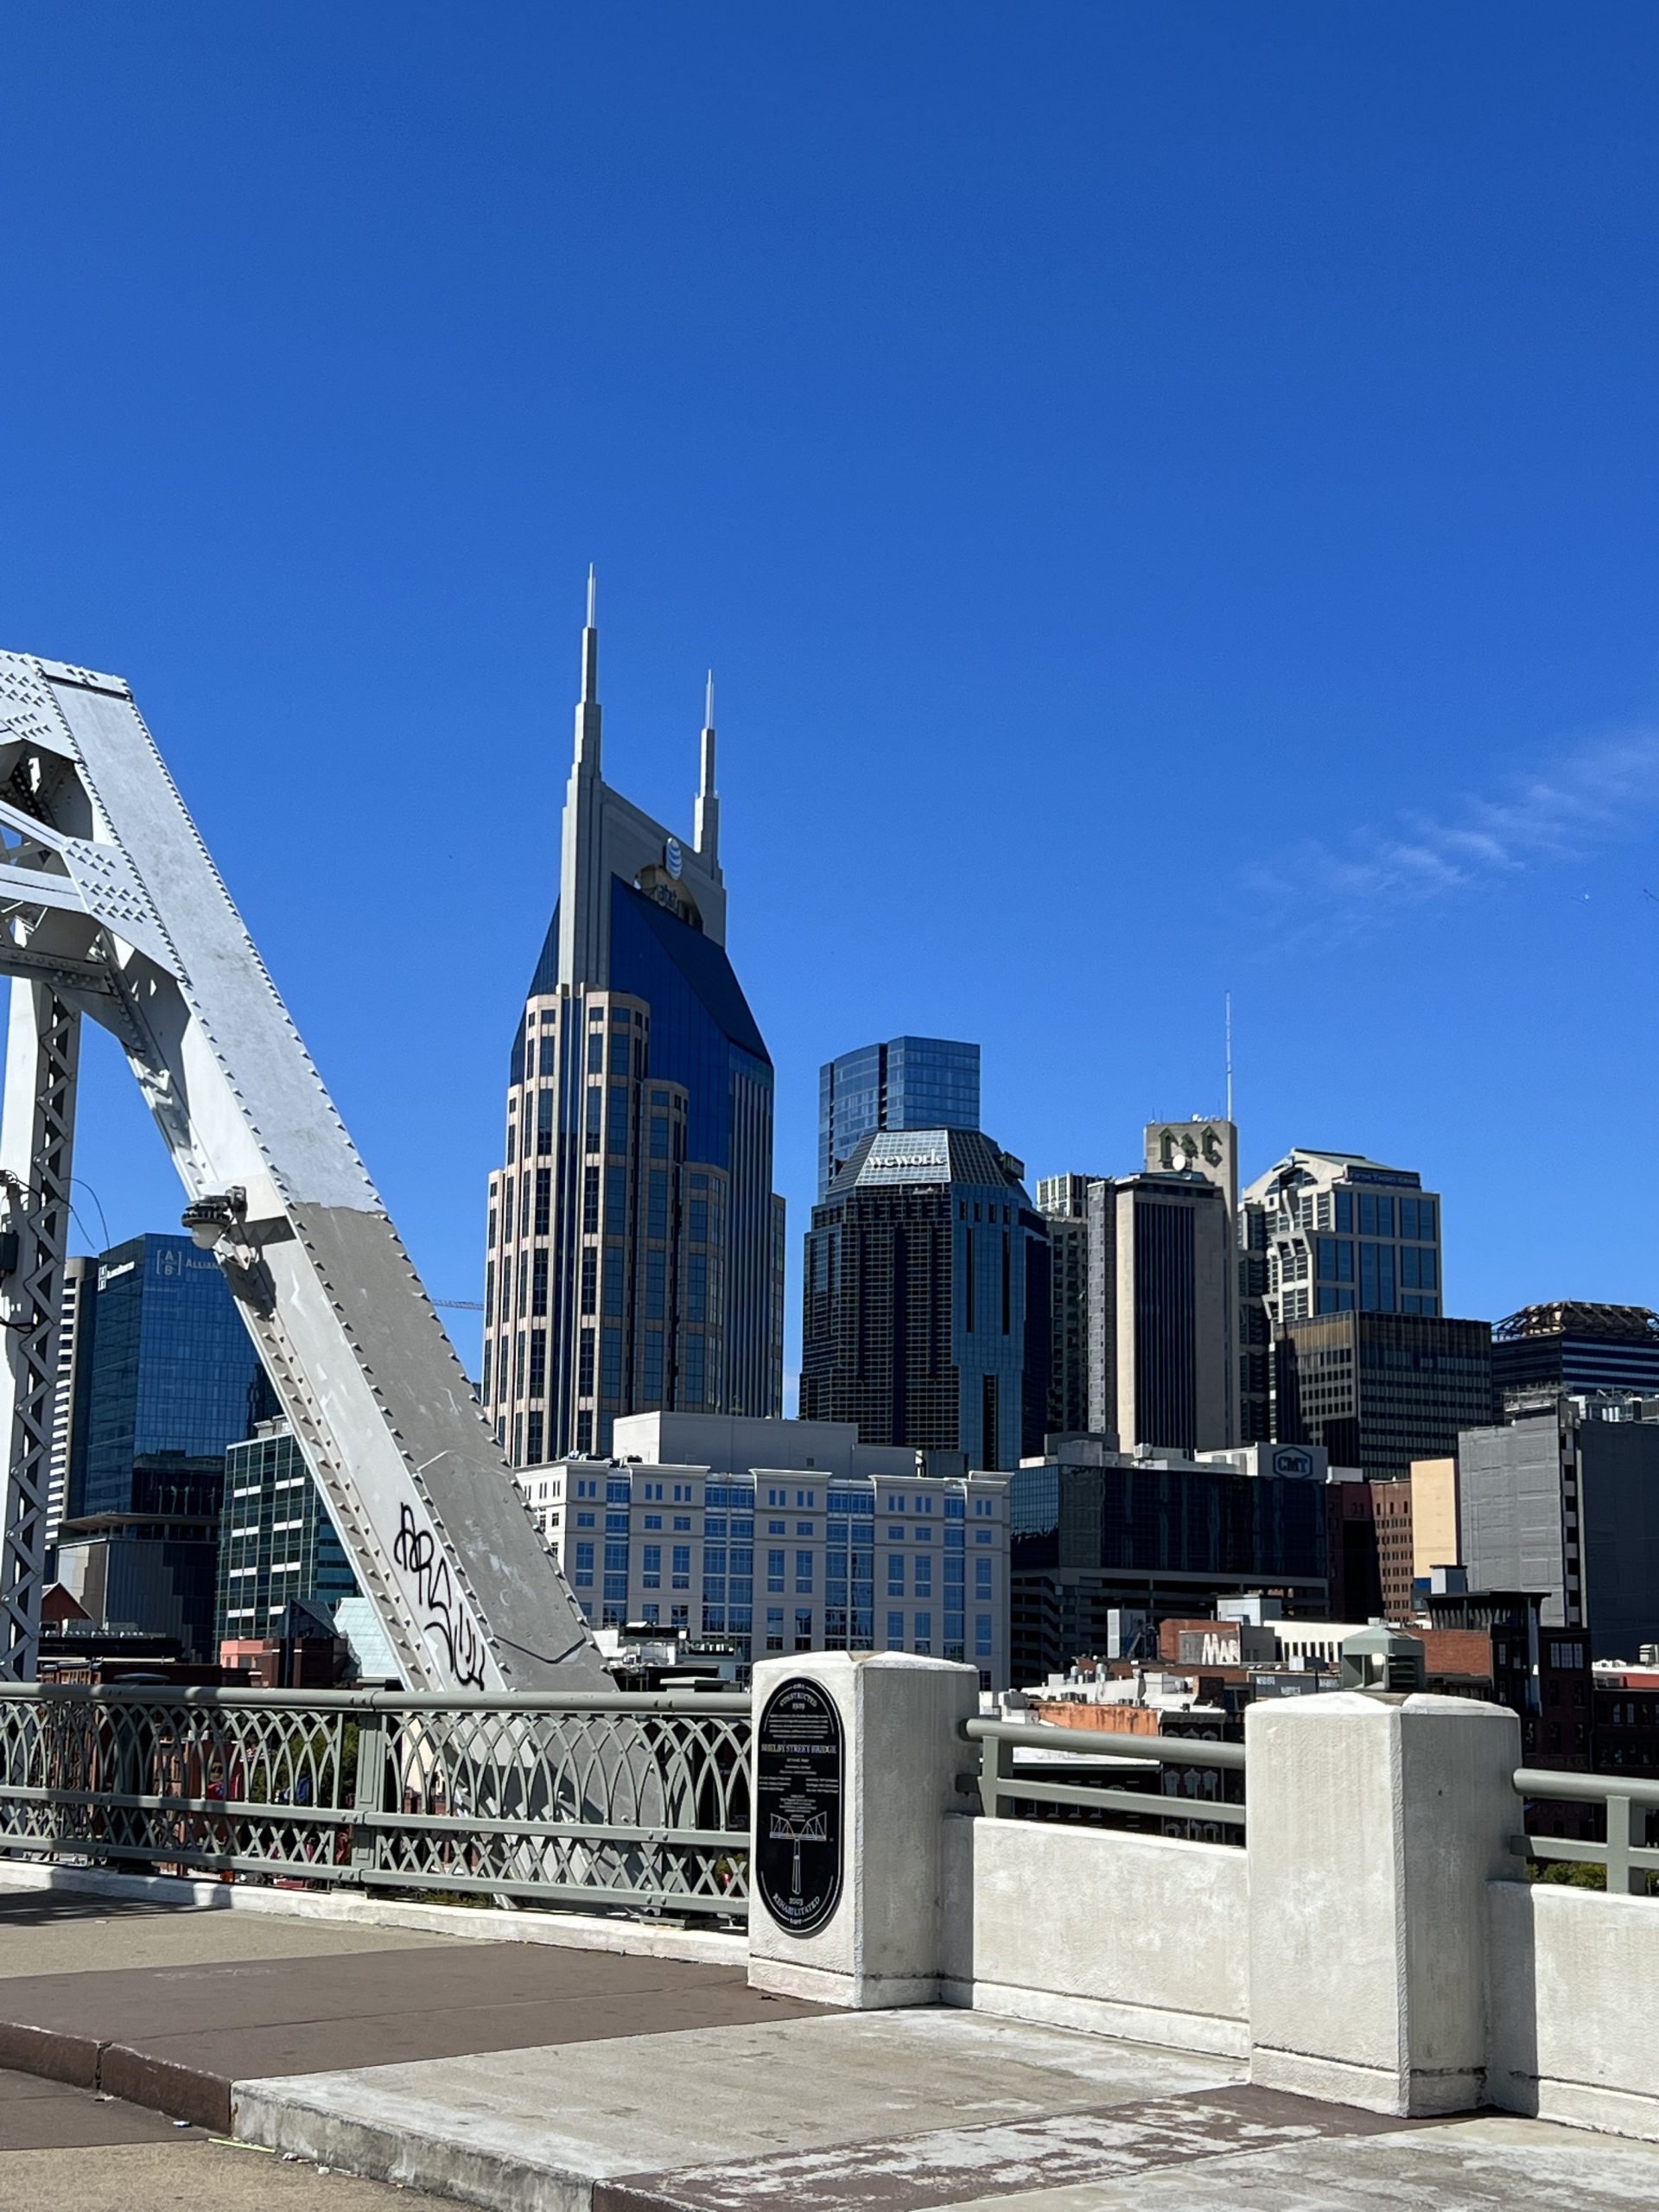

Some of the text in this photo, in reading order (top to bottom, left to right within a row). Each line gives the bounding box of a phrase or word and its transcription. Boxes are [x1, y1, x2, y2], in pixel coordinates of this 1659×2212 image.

[868, 1148, 944, 1166] wework
[1277, 1456, 1308, 1473] CMT
[761, 1744, 785, 1753] SHELBY
[785, 1744, 810, 1754] STREET
[772, 1892, 820, 1916] REHABILITATED
